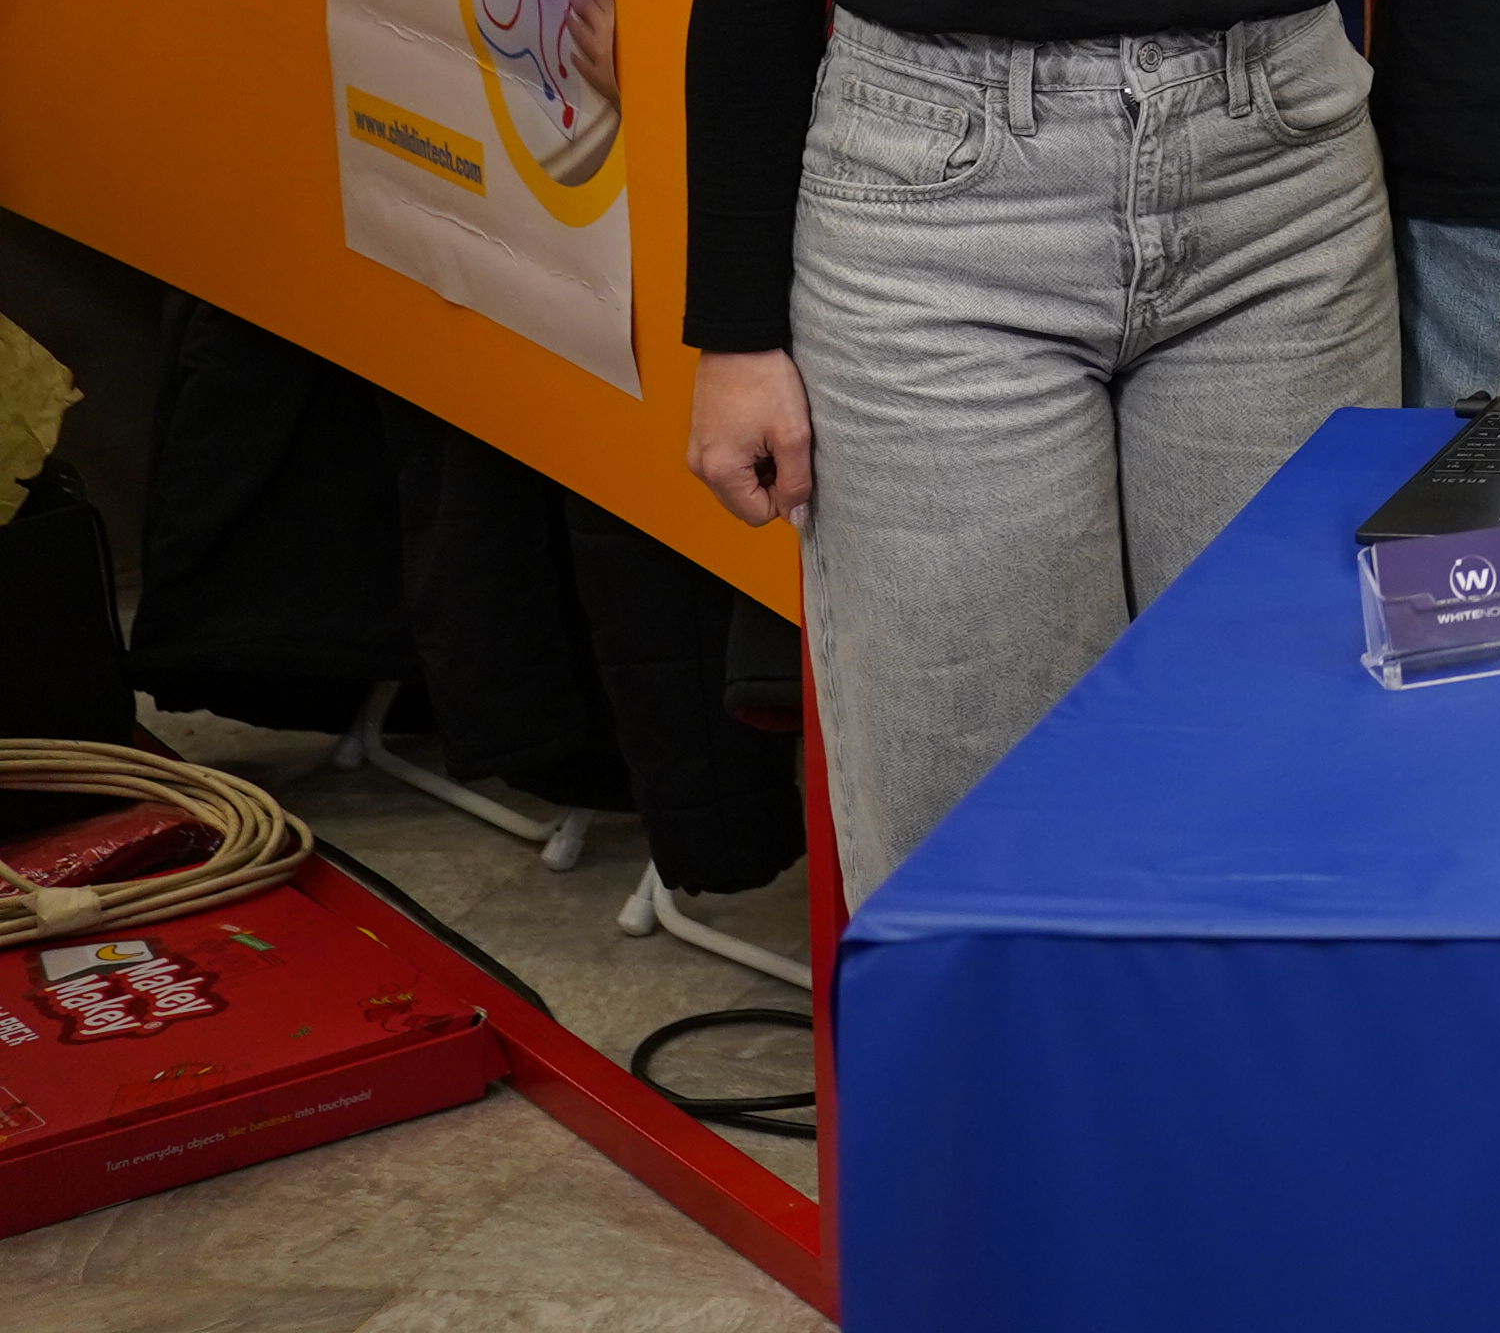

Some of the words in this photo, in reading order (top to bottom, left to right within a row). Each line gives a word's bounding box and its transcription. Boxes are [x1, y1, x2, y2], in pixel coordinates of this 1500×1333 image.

[353, 109, 482, 186] www.childintech.com
[50, 974, 142, 1036] Makey
[115, 958, 217, 1018] Makey
[105, 1159, 130, 1173] Turn
[132, 1142, 184, 1165] everyday
[187, 1131, 225, 1151] objects
[227, 1124, 246, 1139] like
[249, 1112, 293, 1133] bananas
[295, 1107, 315, 1120] into
[317, 1089, 373, 1114] touchpads!
